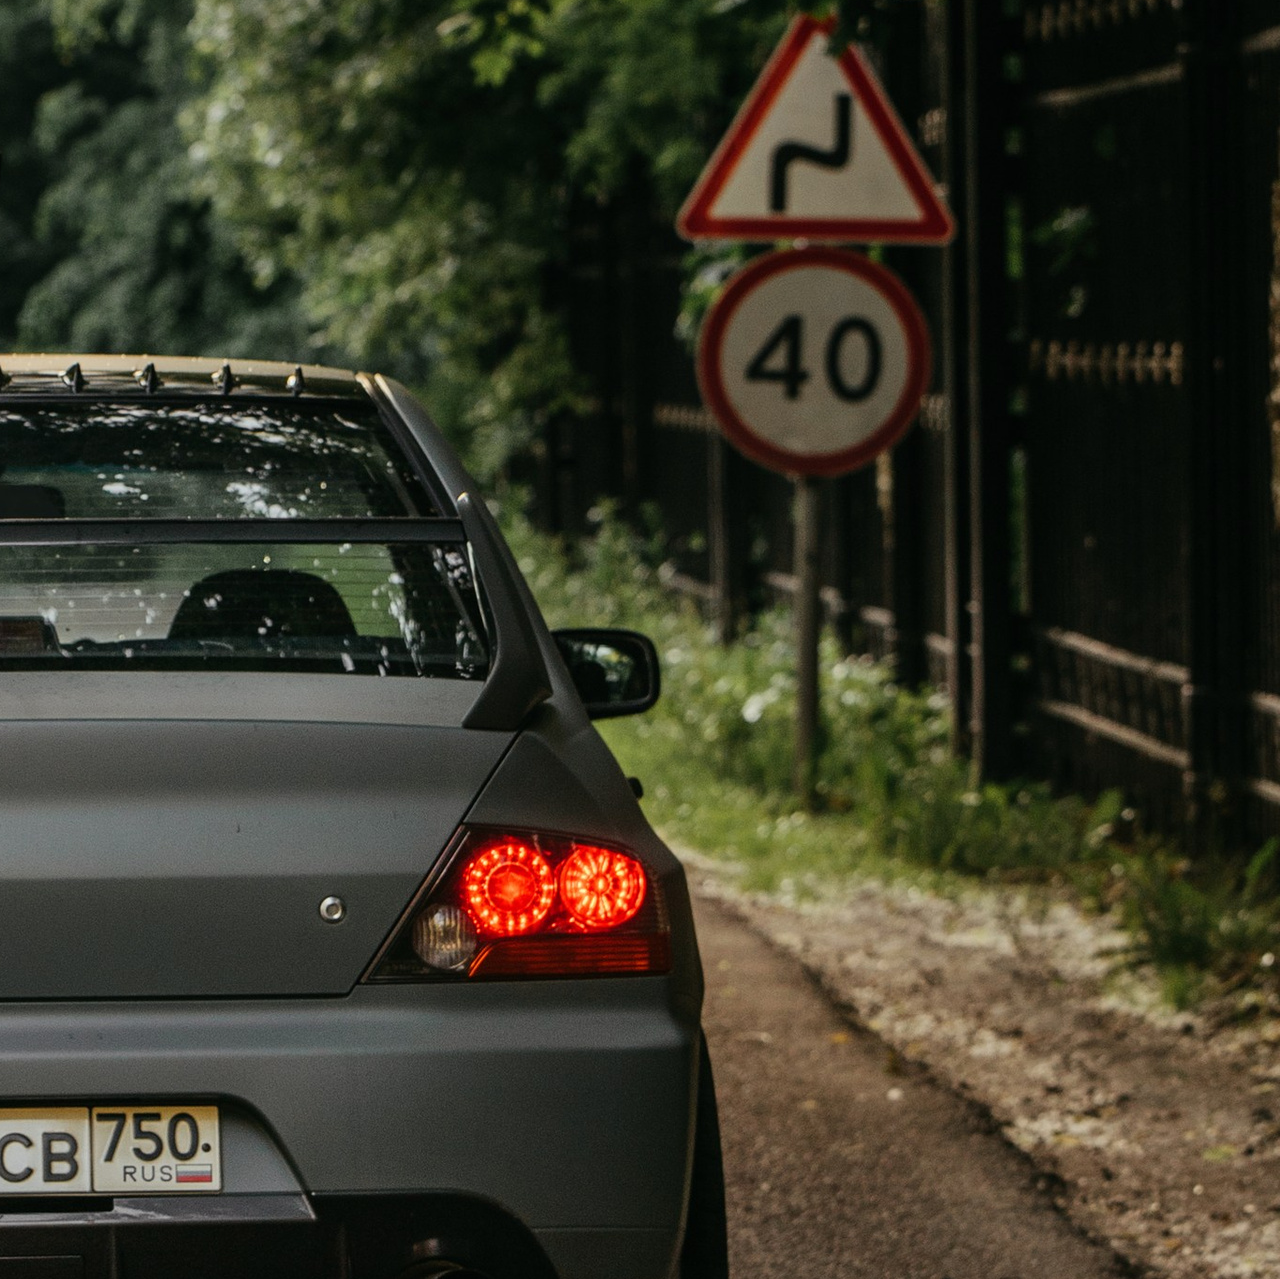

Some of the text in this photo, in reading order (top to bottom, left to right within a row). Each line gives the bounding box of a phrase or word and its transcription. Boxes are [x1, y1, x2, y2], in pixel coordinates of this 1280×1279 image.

[745, 314, 883, 403] 40
[96, 1112, 199, 1163] 750
[123, 1165, 173, 1182] RUS
